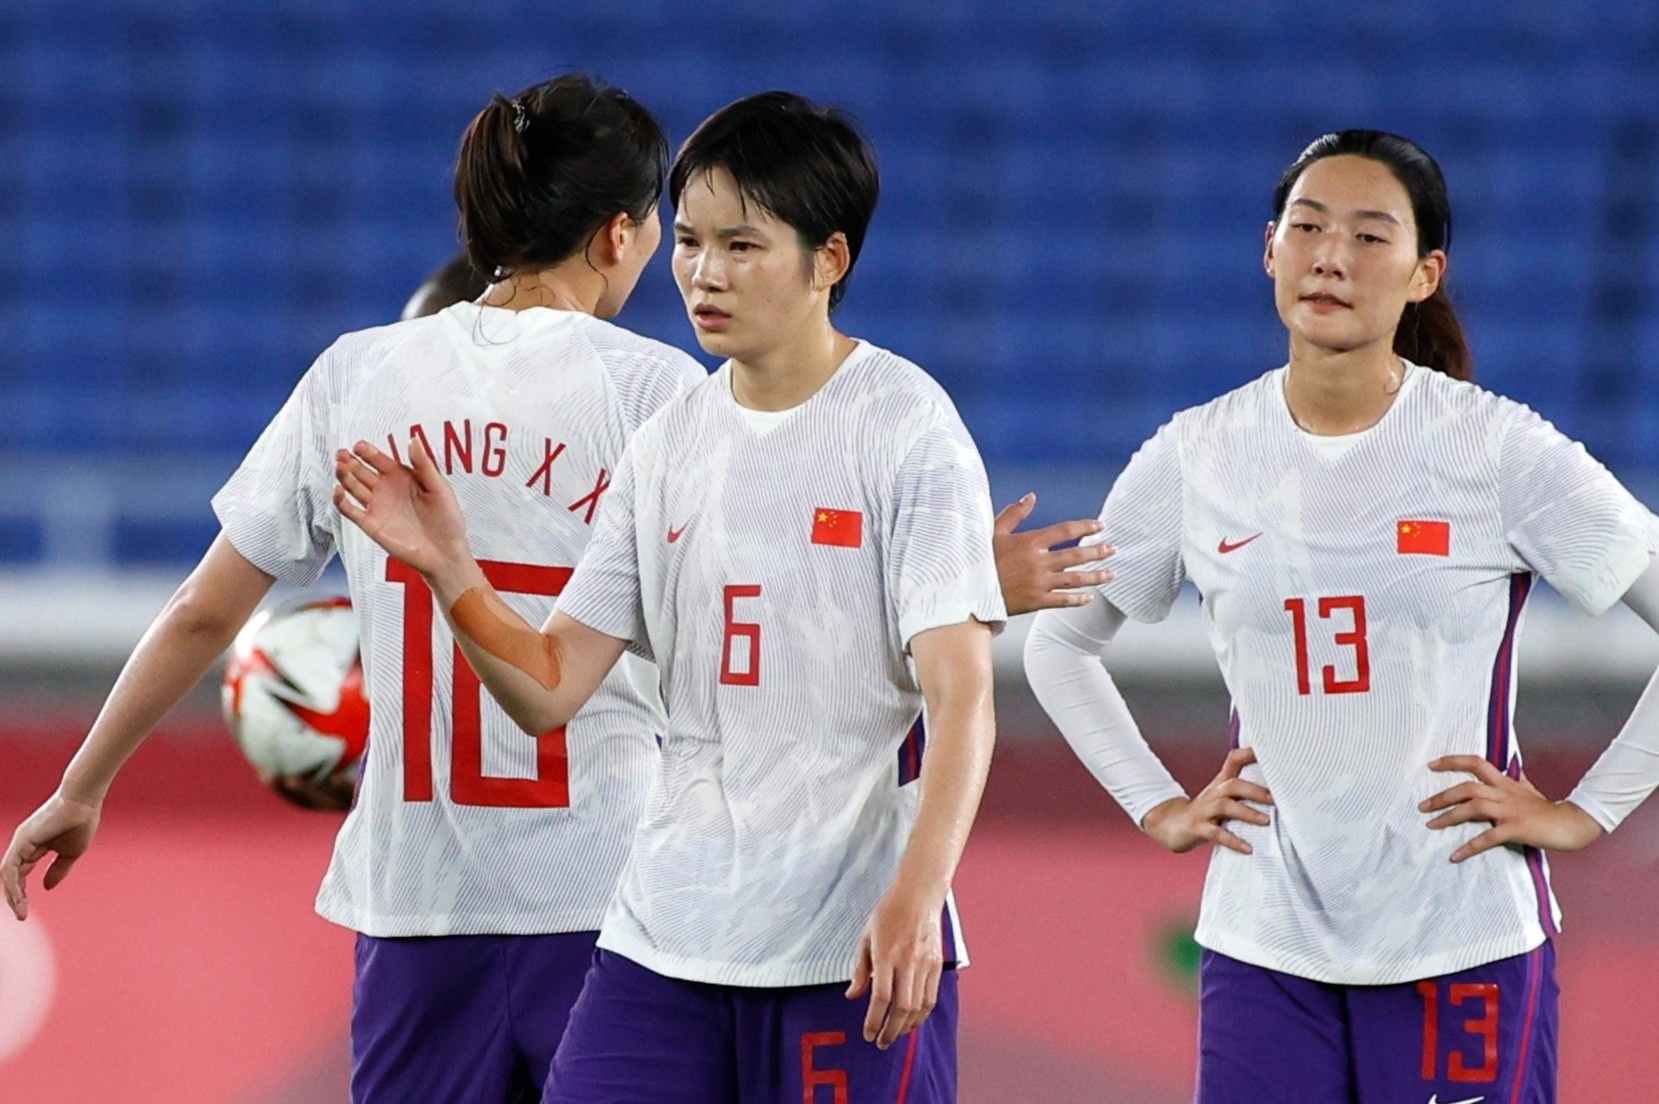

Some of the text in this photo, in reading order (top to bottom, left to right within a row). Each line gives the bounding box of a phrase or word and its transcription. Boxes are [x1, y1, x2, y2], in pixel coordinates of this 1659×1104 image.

[387, 418, 508, 477] ANG
[719, 584, 762, 687] 6
[1284, 594, 1371, 696] 13
[800, 1030, 849, 1104] 6
[1416, 981, 1500, 1084] 13
